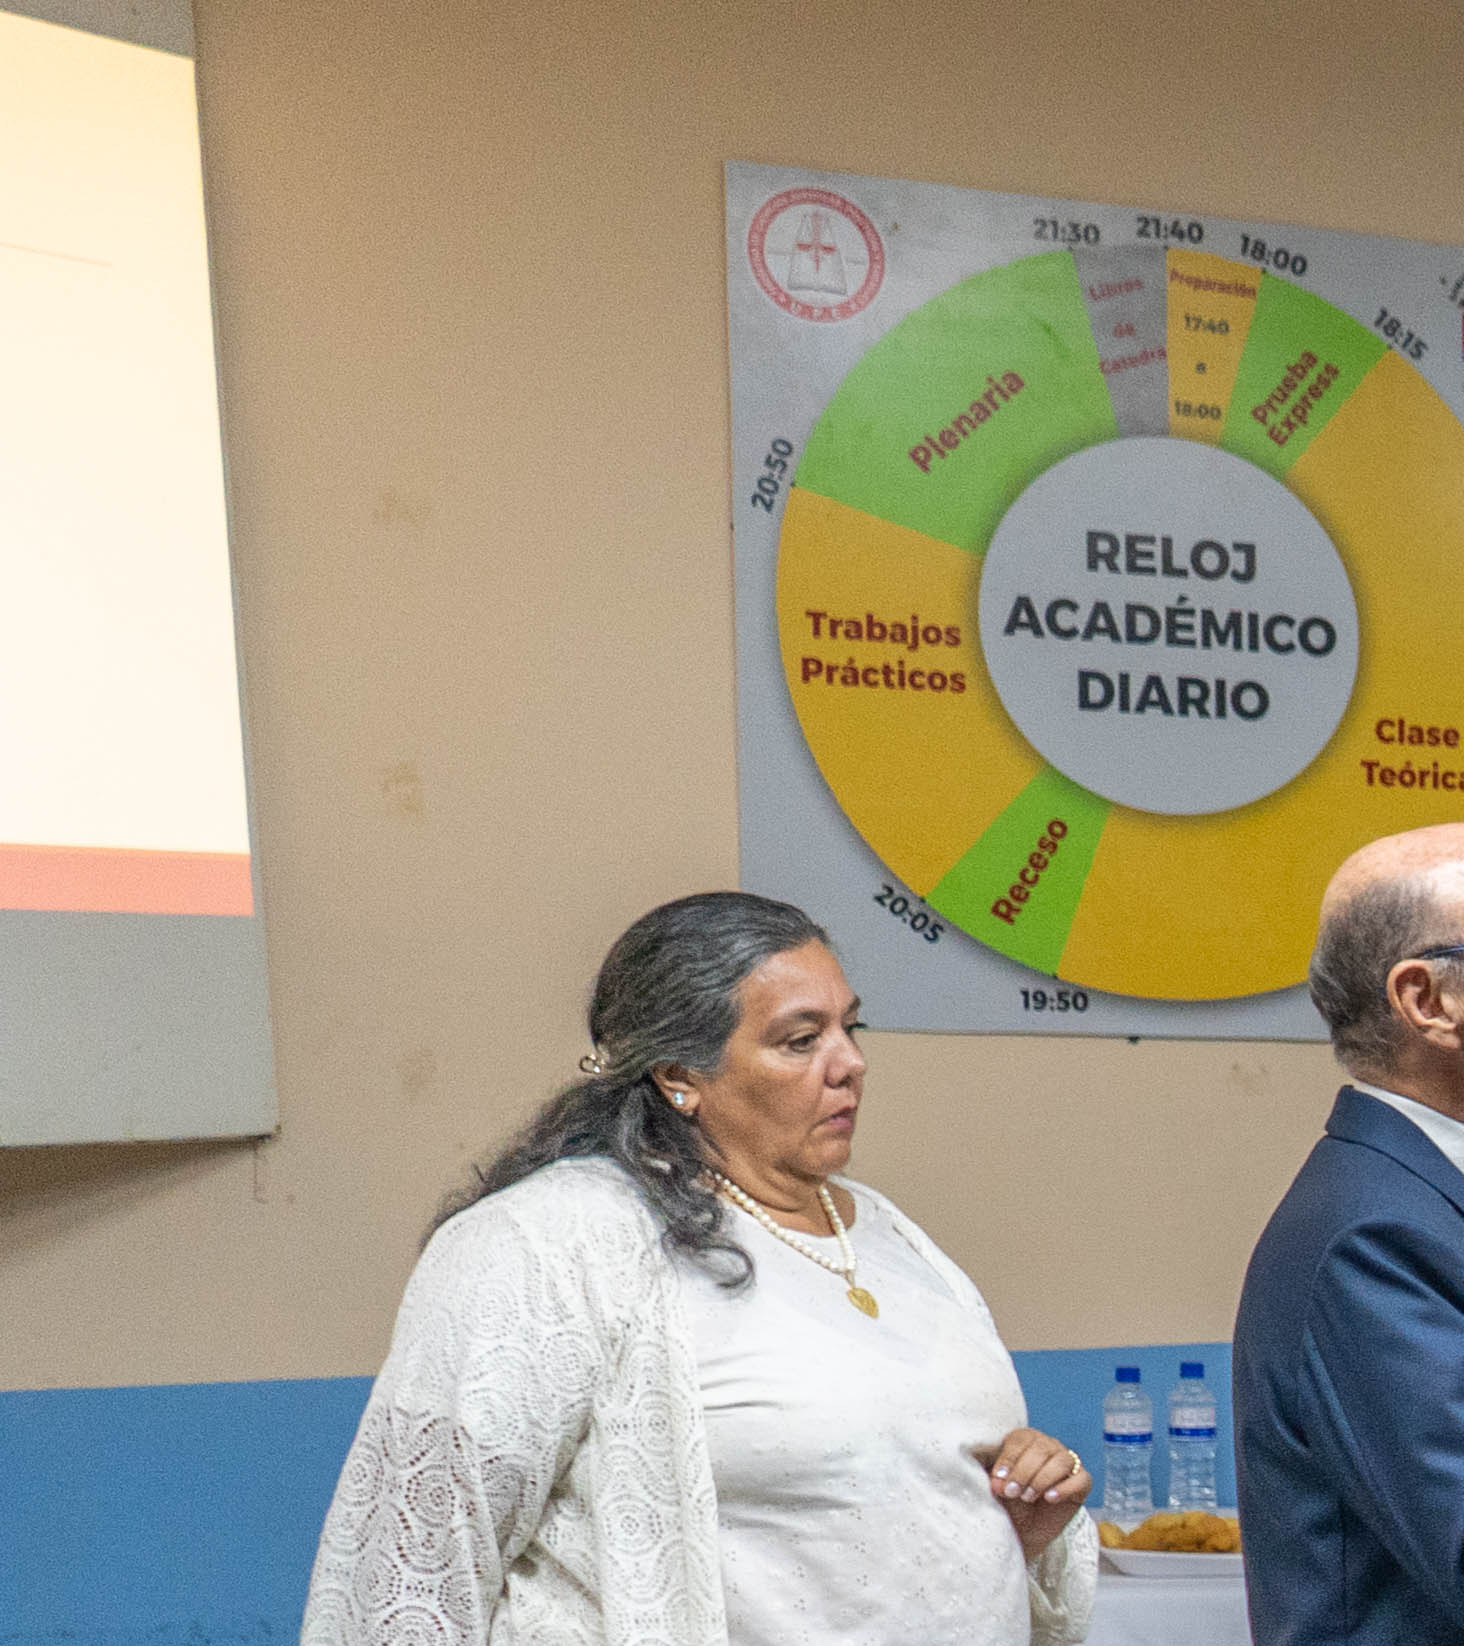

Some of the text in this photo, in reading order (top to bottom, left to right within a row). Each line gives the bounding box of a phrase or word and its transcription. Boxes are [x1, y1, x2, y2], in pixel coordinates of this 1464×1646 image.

[1033, 218, 1100, 245] 21:30
[1136, 216, 1204, 244] 21:40
[1240, 234, 1308, 275] 18:00
[1184, 313, 1230, 336] 17:40
[1374, 306, 1429, 360] 18:15
[1174, 400, 1222, 421] 18:00
[1251, 350, 1318, 427] Prueba
[1267, 363, 1340, 448] Express
[909, 370, 1025, 475] Plenaria
[751, 438, 794, 513] 20:50
[1086, 530, 1257, 584] RELOJ
[805, 609, 962, 652] Trabajos
[1003, 594, 1337, 657] ACADÉMICO
[800, 657, 967, 694] Prácticos
[1078, 669, 1270, 722] DIARIO
[1375, 716, 1460, 748] Clase
[989, 818, 1068, 927] Receso
[874, 882, 945, 944] 20:05
[1020, 989, 1089, 1012] 19:50
